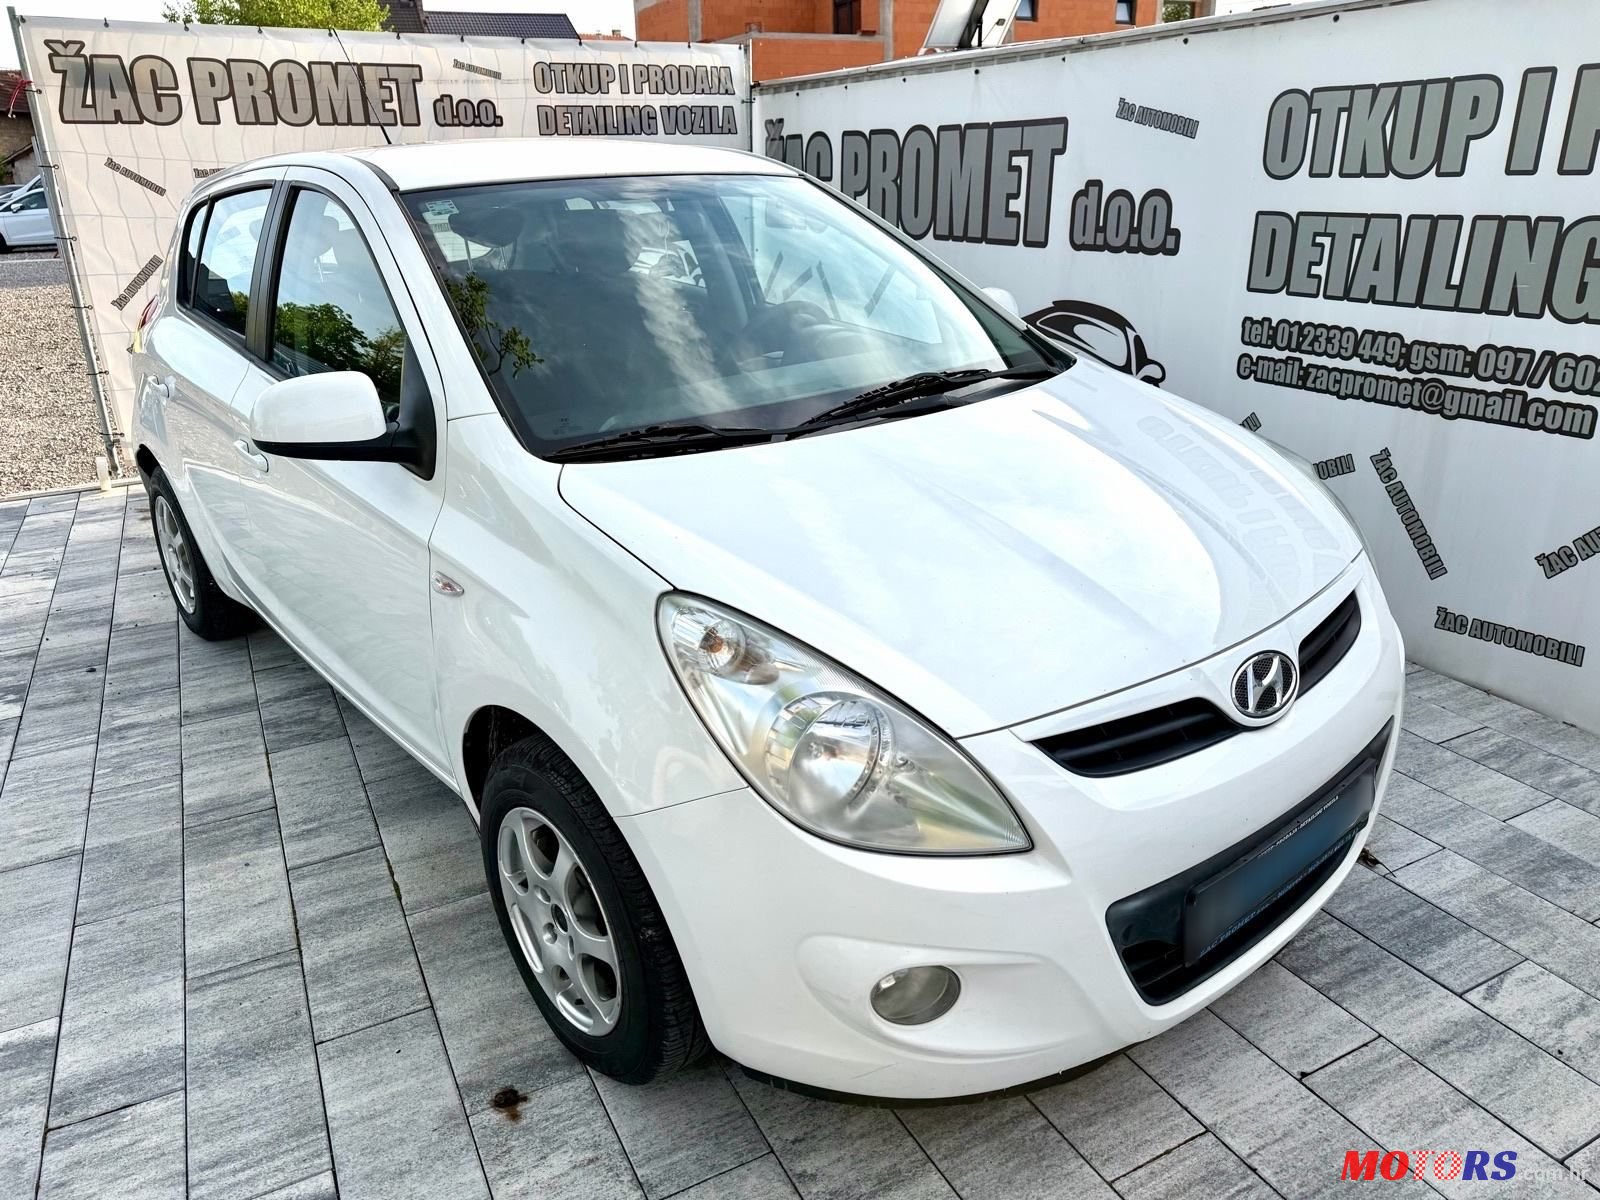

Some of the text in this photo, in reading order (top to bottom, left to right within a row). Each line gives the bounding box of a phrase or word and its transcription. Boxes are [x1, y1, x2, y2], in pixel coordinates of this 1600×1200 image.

[44, 40, 503, 127] ŽAC PROMET d.o.o.
[533, 61, 736, 95] OTKUP I PRODAJA
[537, 105, 738, 135] DETAILING VOZILA
[1116, 97, 1200, 139] ŽAC AUTOMOBILI
[1262, 73, 1504, 180] OTKUP
[1505, 66, 1557, 176] I
[841, 116, 1068, 249] PROMET
[1069, 179, 1181, 256] d.o.o.
[124, 254, 164, 297] AUTOMOBILI
[1246, 211, 1600, 325] DETAILING
[1241, 316, 1274, 349] tel:
[1407, 339, 1476, 378] gsm:
[1237, 353, 1598, 440] e-mail: zacpromet@gmail.com
[1369, 447, 1448, 580] ŽAC AUTOMOBILI
[1534, 545, 1578, 579] ŽAC
[1434, 606, 1585, 667] ŽAC AUTOMOBILI
